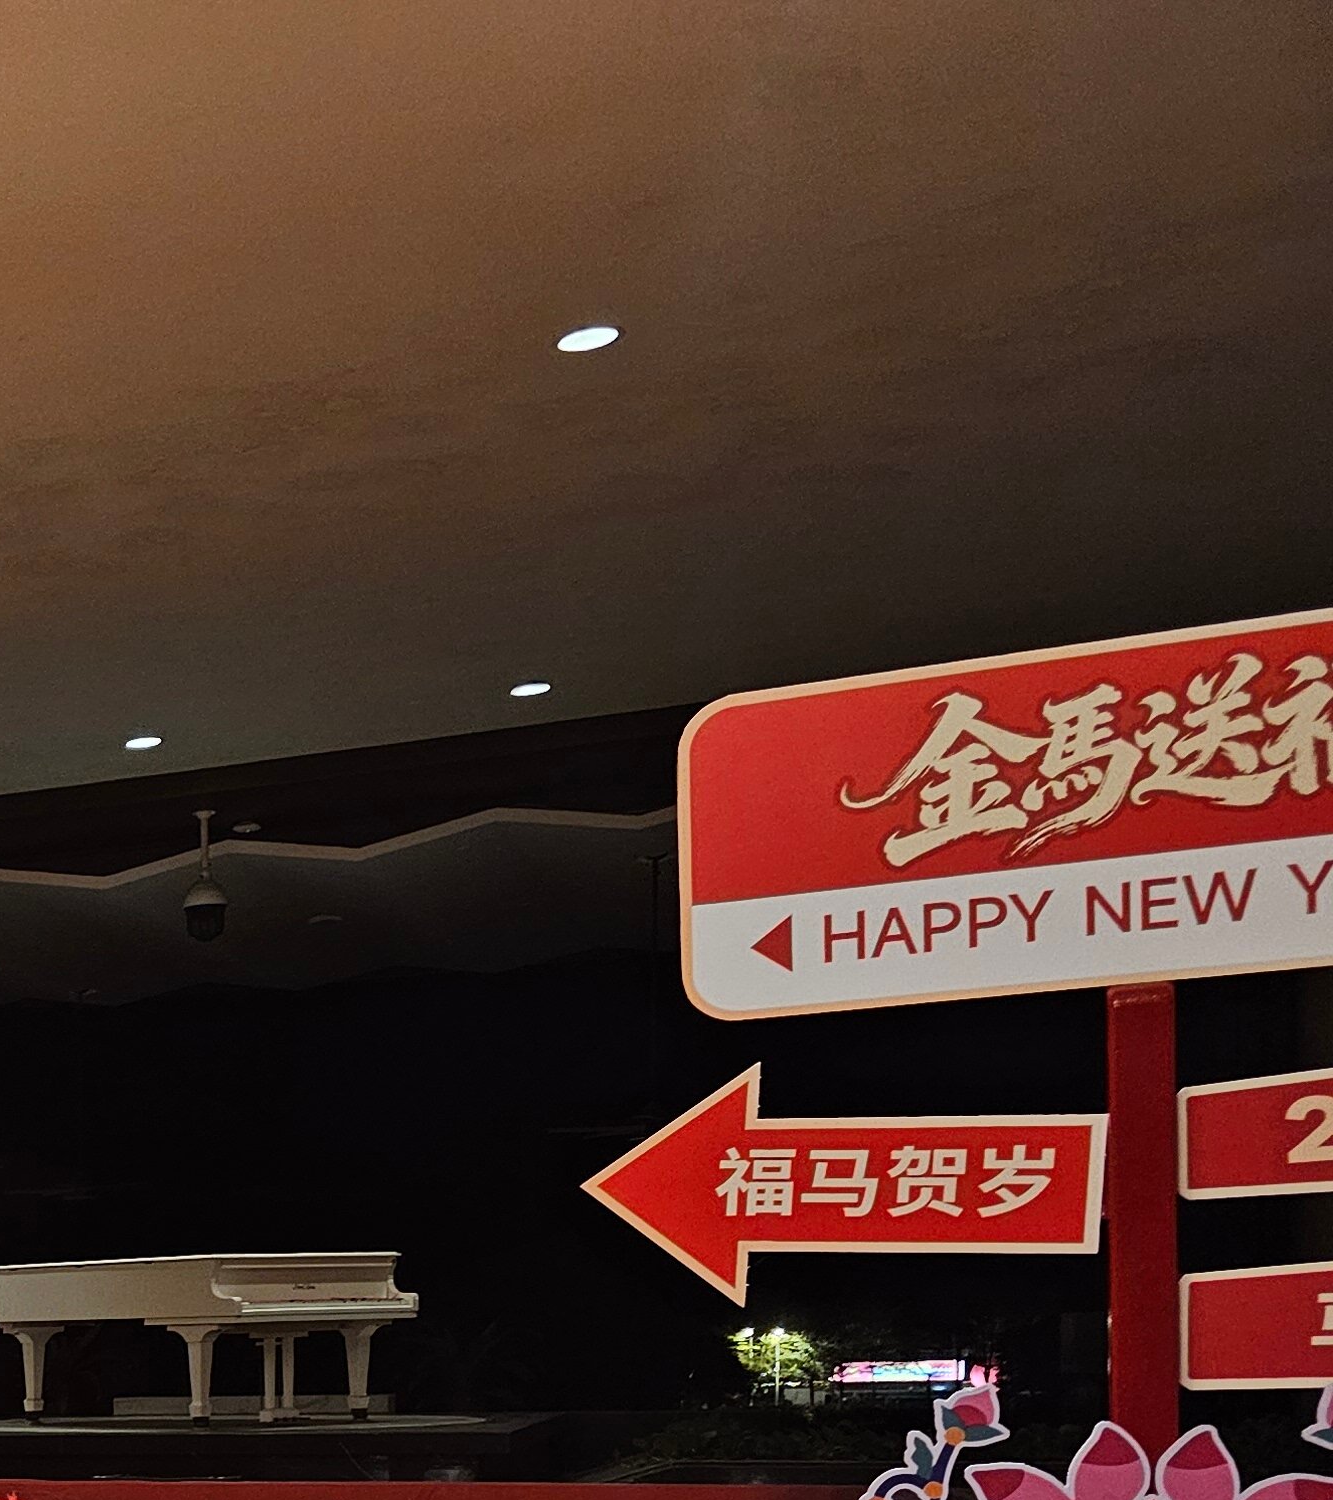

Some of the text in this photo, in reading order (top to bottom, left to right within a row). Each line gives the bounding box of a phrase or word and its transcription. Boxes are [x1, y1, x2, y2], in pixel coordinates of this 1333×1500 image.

[822, 890, 1055, 964] HAPPY
[1085, 868, 1258, 937] NEW
[715, 1146, 1058, 1218] 福马贺岁
